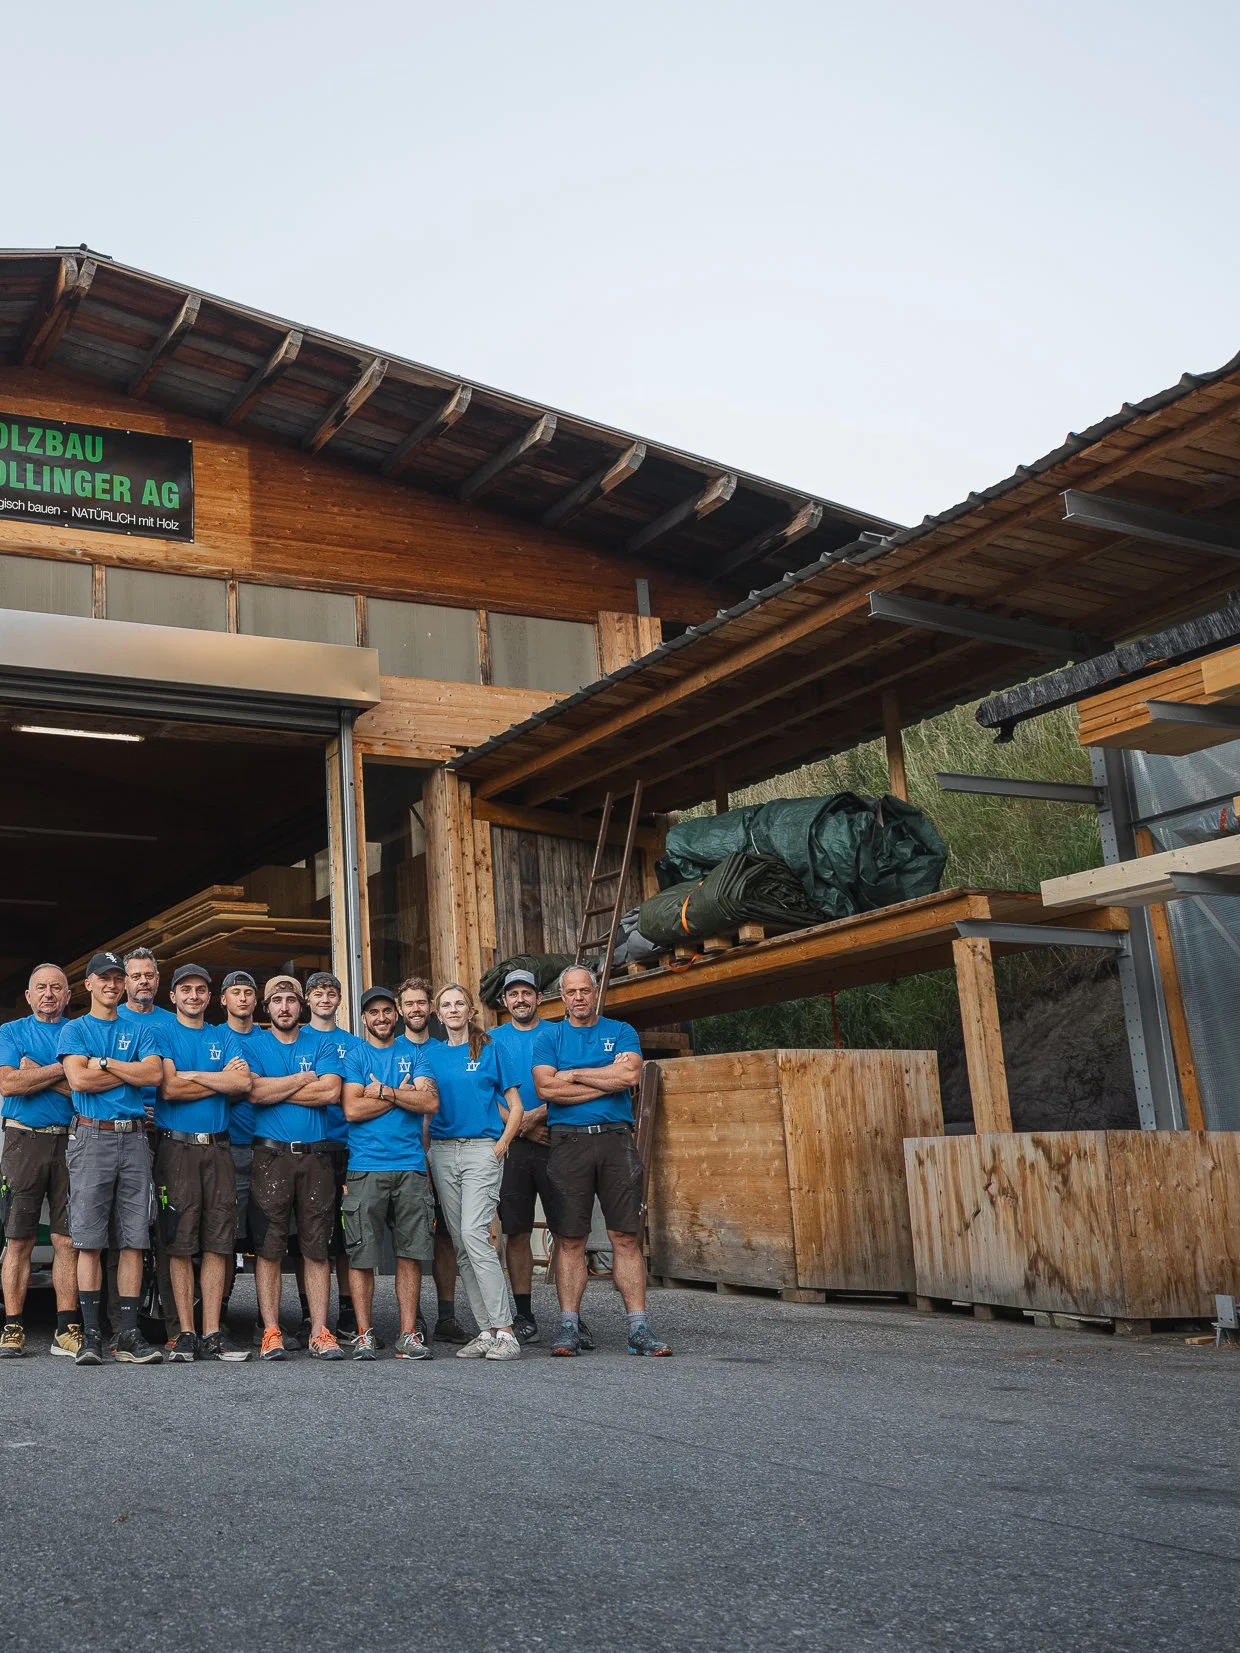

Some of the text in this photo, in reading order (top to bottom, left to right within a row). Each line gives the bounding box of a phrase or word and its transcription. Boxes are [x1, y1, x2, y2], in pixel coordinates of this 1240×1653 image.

[141, 479, 179, 509] AG
[28, 501, 61, 515] bauen
[71, 506, 136, 525] NATÜRLICH
[138, 516, 154, 527] mit
[156, 517, 179, 531] Holz
